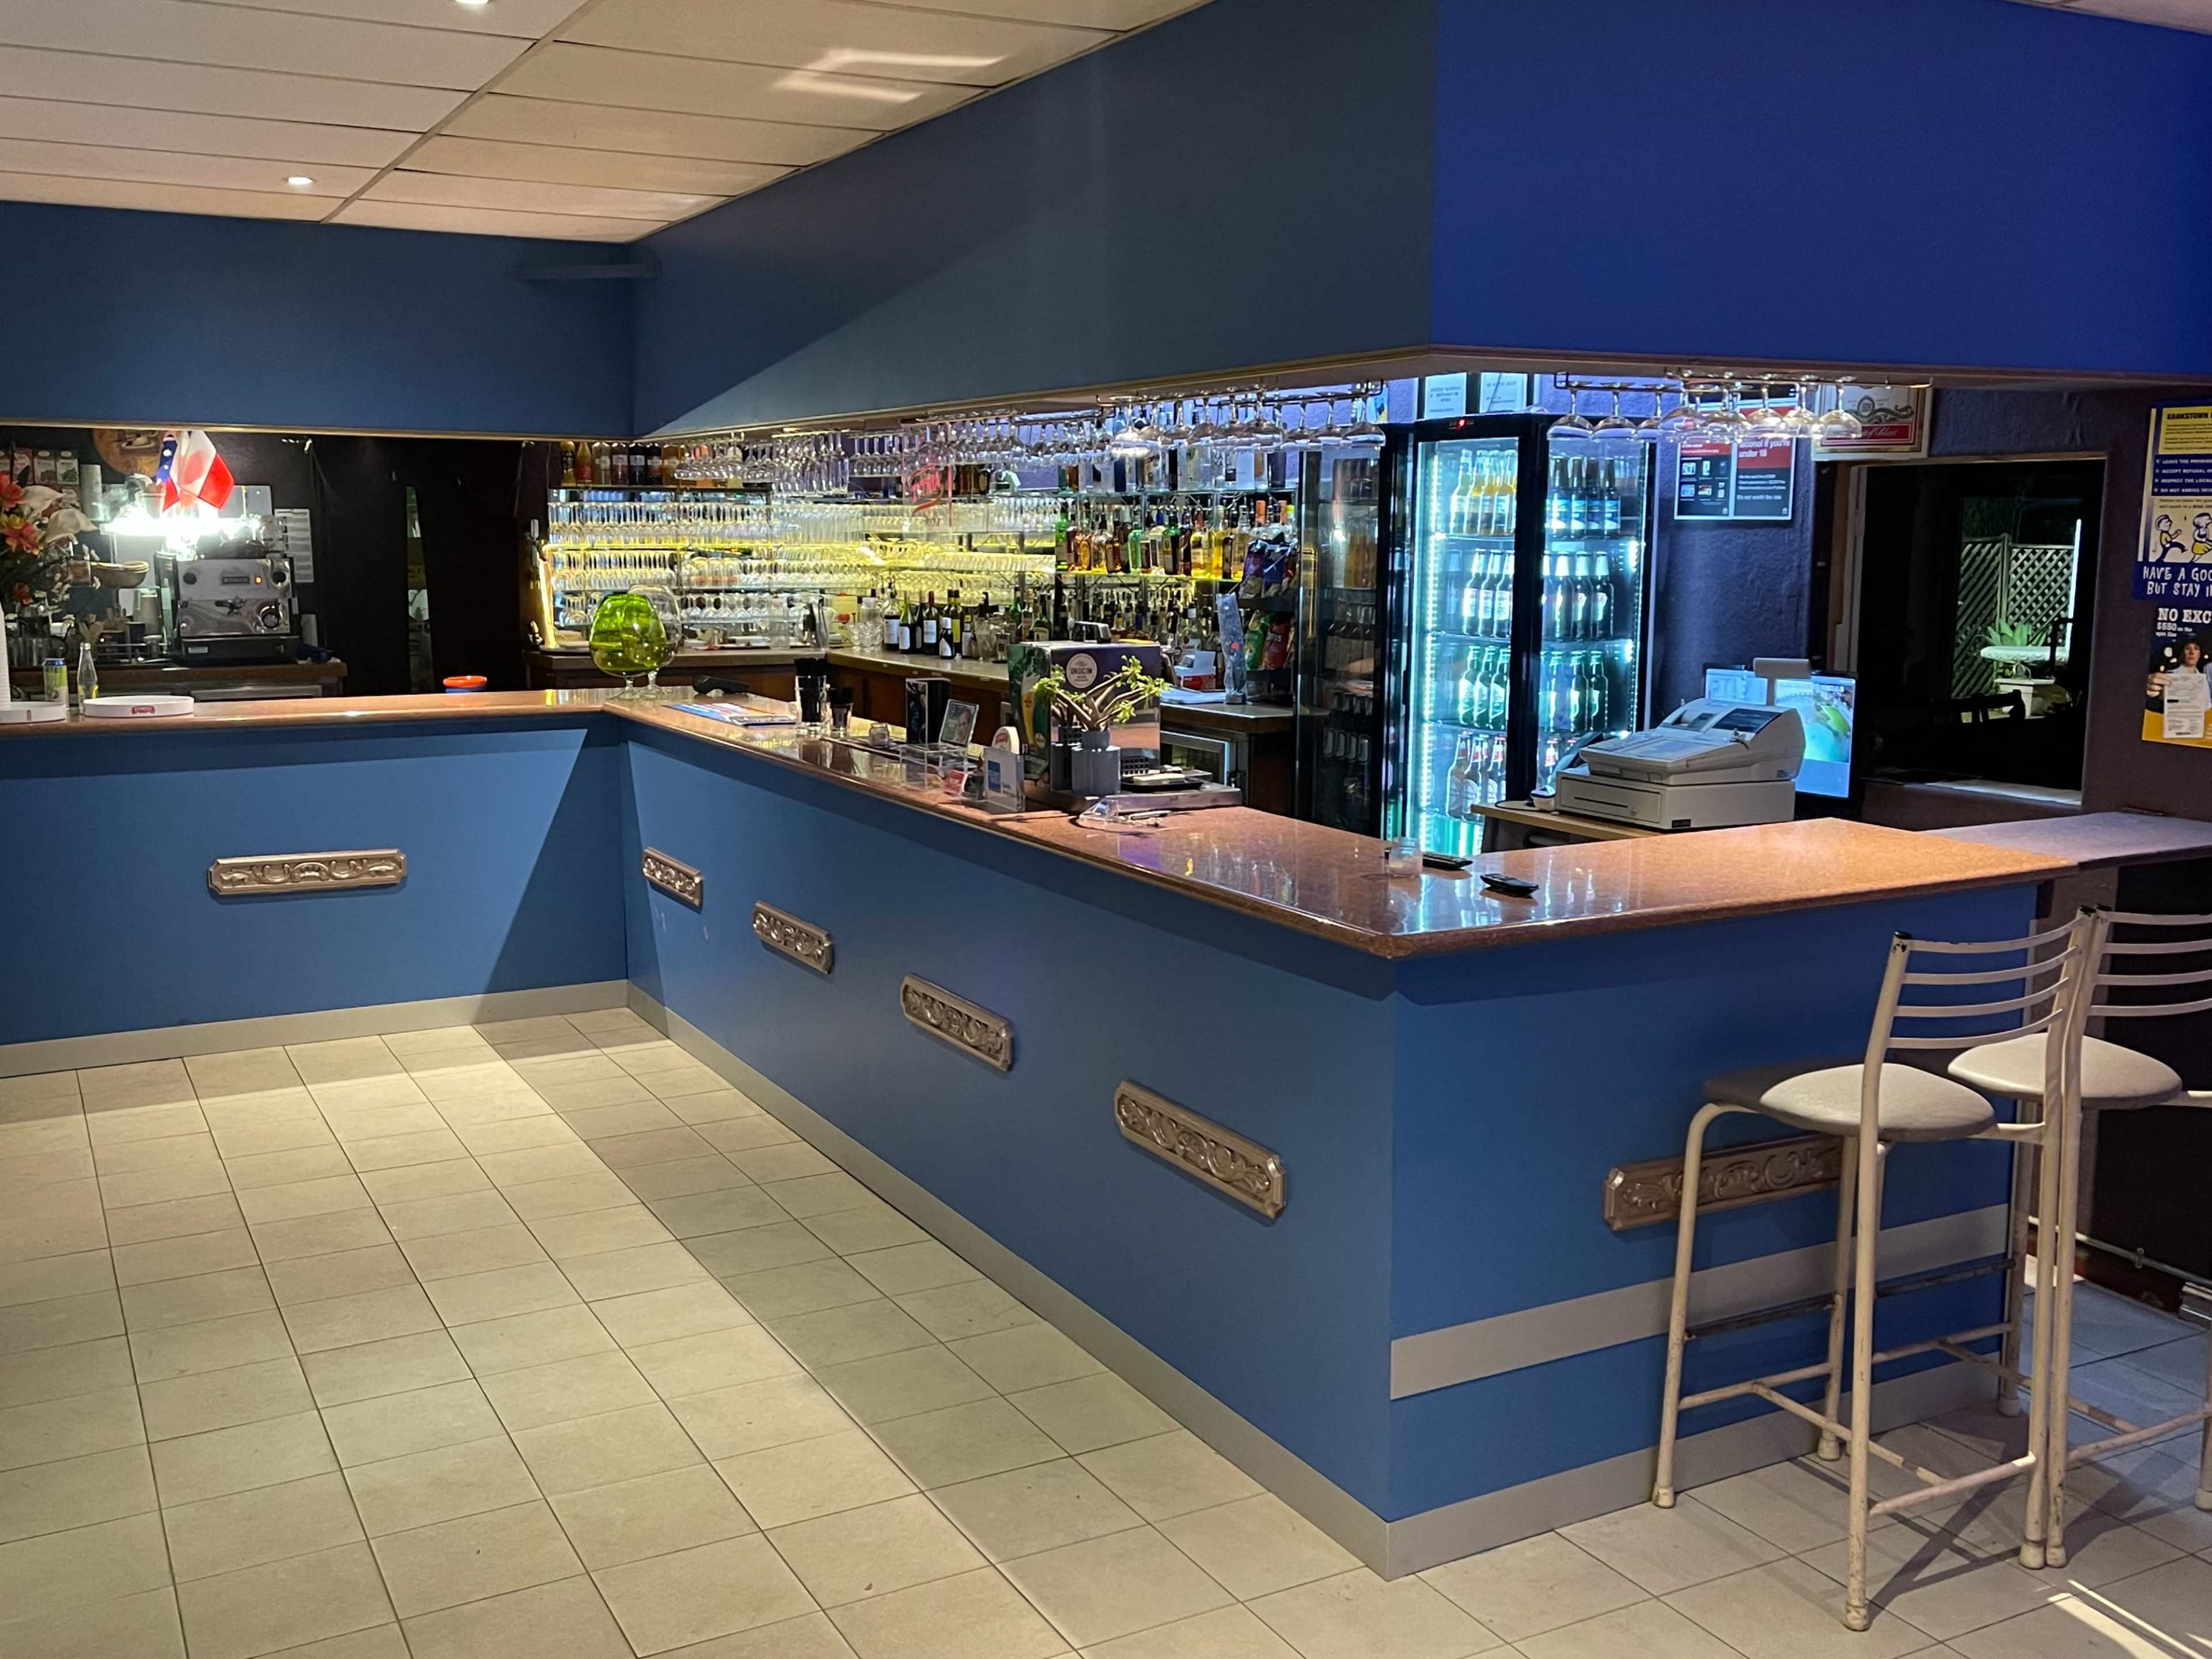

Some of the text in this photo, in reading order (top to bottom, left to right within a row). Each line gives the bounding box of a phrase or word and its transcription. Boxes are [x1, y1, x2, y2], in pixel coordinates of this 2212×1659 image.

[2143, 566, 2172, 580] HAVE
[2177, 567, 2186, 581] A
[2147, 581, 2168, 594] BUT
[2173, 582, 2200, 597] STAY
[2157, 608, 2212, 624] NO EXC
[2157, 622, 2177, 631] $550
